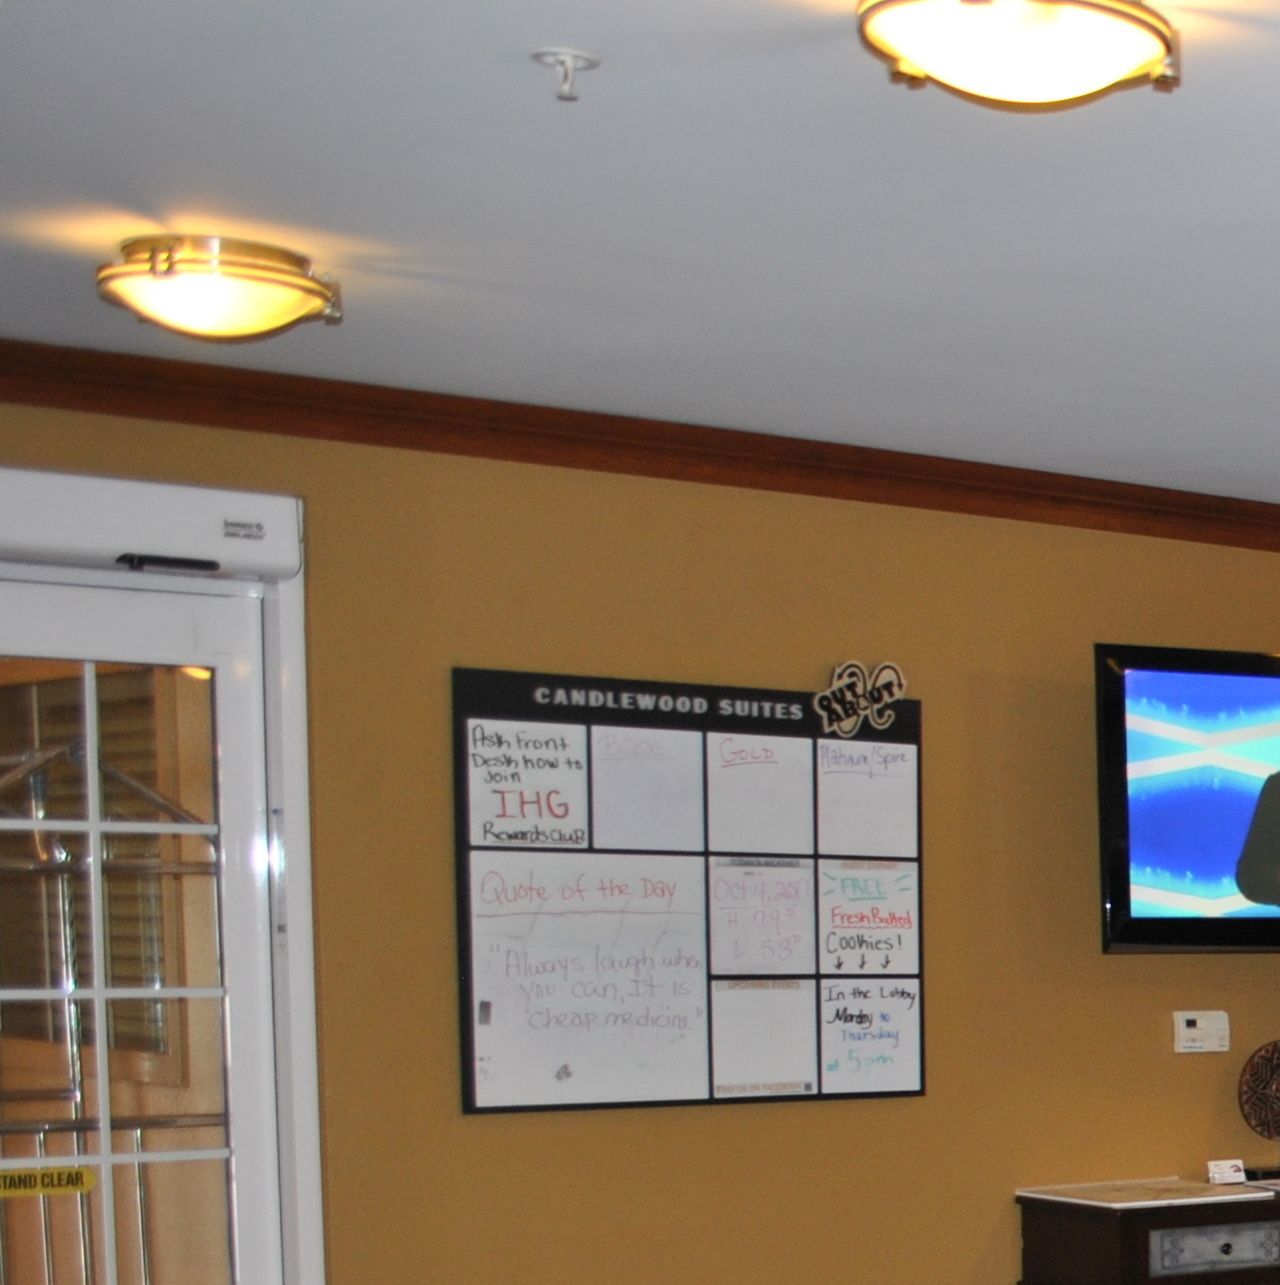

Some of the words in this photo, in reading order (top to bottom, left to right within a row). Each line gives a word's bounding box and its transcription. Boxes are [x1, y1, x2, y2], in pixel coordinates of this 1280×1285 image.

[534, 687, 708, 715] CANDLEWOOD
[718, 699, 804, 721] SUITES
[522, 754, 559, 770] how
[564, 758, 584, 770] to
[491, 789, 569, 819] IHG
[479, 870, 549, 905] Quote
[561, 873, 588, 900] of
[597, 878, 630, 898] the
[640, 877, 678, 899] Day
[831, 905, 871, 925] Fresh
[595, 946, 656, 976] laugh
[661, 948, 703, 970] when
[673, 982, 692, 997] is
[824, 984, 847, 1002] In
[849, 987, 872, 1001] the
[880, 985, 917, 1010] Lobby
[528, 1007, 598, 1032] cheap
[825, 1006, 874, 1030] Monday
[0, 1174, 38, 1191] TAND
[41, 1171, 85, 1189] CLEAR
